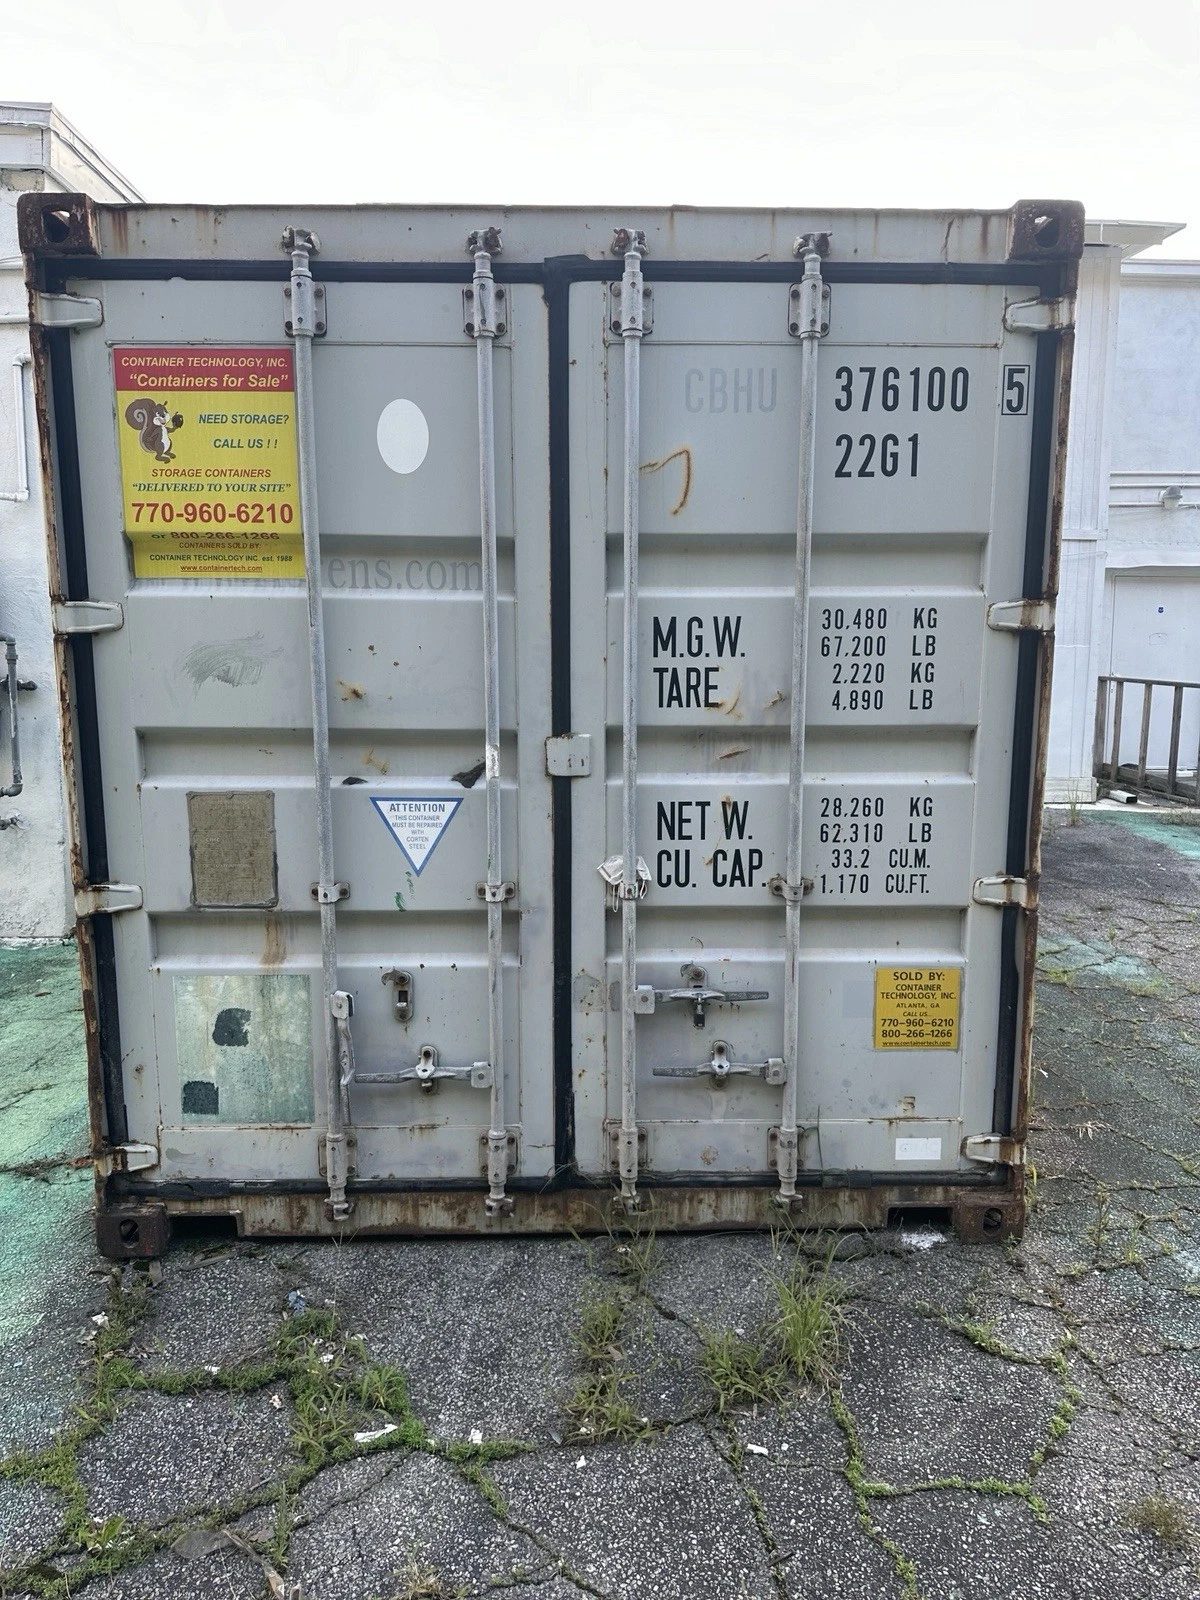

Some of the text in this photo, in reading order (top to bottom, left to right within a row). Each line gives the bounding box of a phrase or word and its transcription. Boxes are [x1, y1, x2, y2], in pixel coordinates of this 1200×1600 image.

[121, 357, 288, 369] CONTAINER TECHNOLOGY, INC.
[222, 374, 244, 387] for
[685, 368, 777, 413] CBHU
[834, 366, 1024, 412] 376100 5
[199, 414, 289, 425] NEED STORAGE?
[213, 439, 244, 449] CALL
[247, 439, 263, 449] US
[834, 433, 919, 478] 22G1
[151, 469, 271, 478] STORAGE CONTAINERS
[207, 484, 222, 492] TO
[225, 484, 257, 492] YOUR
[131, 503, 293, 524] 770-960-6210
[171, 531, 280, 540] 800-266-1266
[193, 554, 244, 562] TECHNOLOGY
[180, 565, 263, 573] www.containertech.com
[913, 607, 937, 629] KG
[653, 616, 746, 658] M.G.W.
[912, 635, 936, 656] LB
[910, 662, 935, 683] KG
[653, 667, 720, 708] TARE
[909, 689, 933, 710] LB
[389, 803, 446, 813] ATTENTION
[909, 797, 933, 817] KG
[656, 800, 753, 841] NET W.
[909, 823, 932, 843] LB
[656, 849, 767, 888] CU. CAP.
[831, 849, 930, 869] 33.2 CU.M.
[885, 874, 929, 894] CU.FT.
[893, 972, 945, 981] SOLD BY:
[880, 992, 957, 1000] TECHNOLOGY, INC.
[881, 1018, 954, 1027] 770-960-6210
[881, 1029, 953, 1038] 800-266-1266
